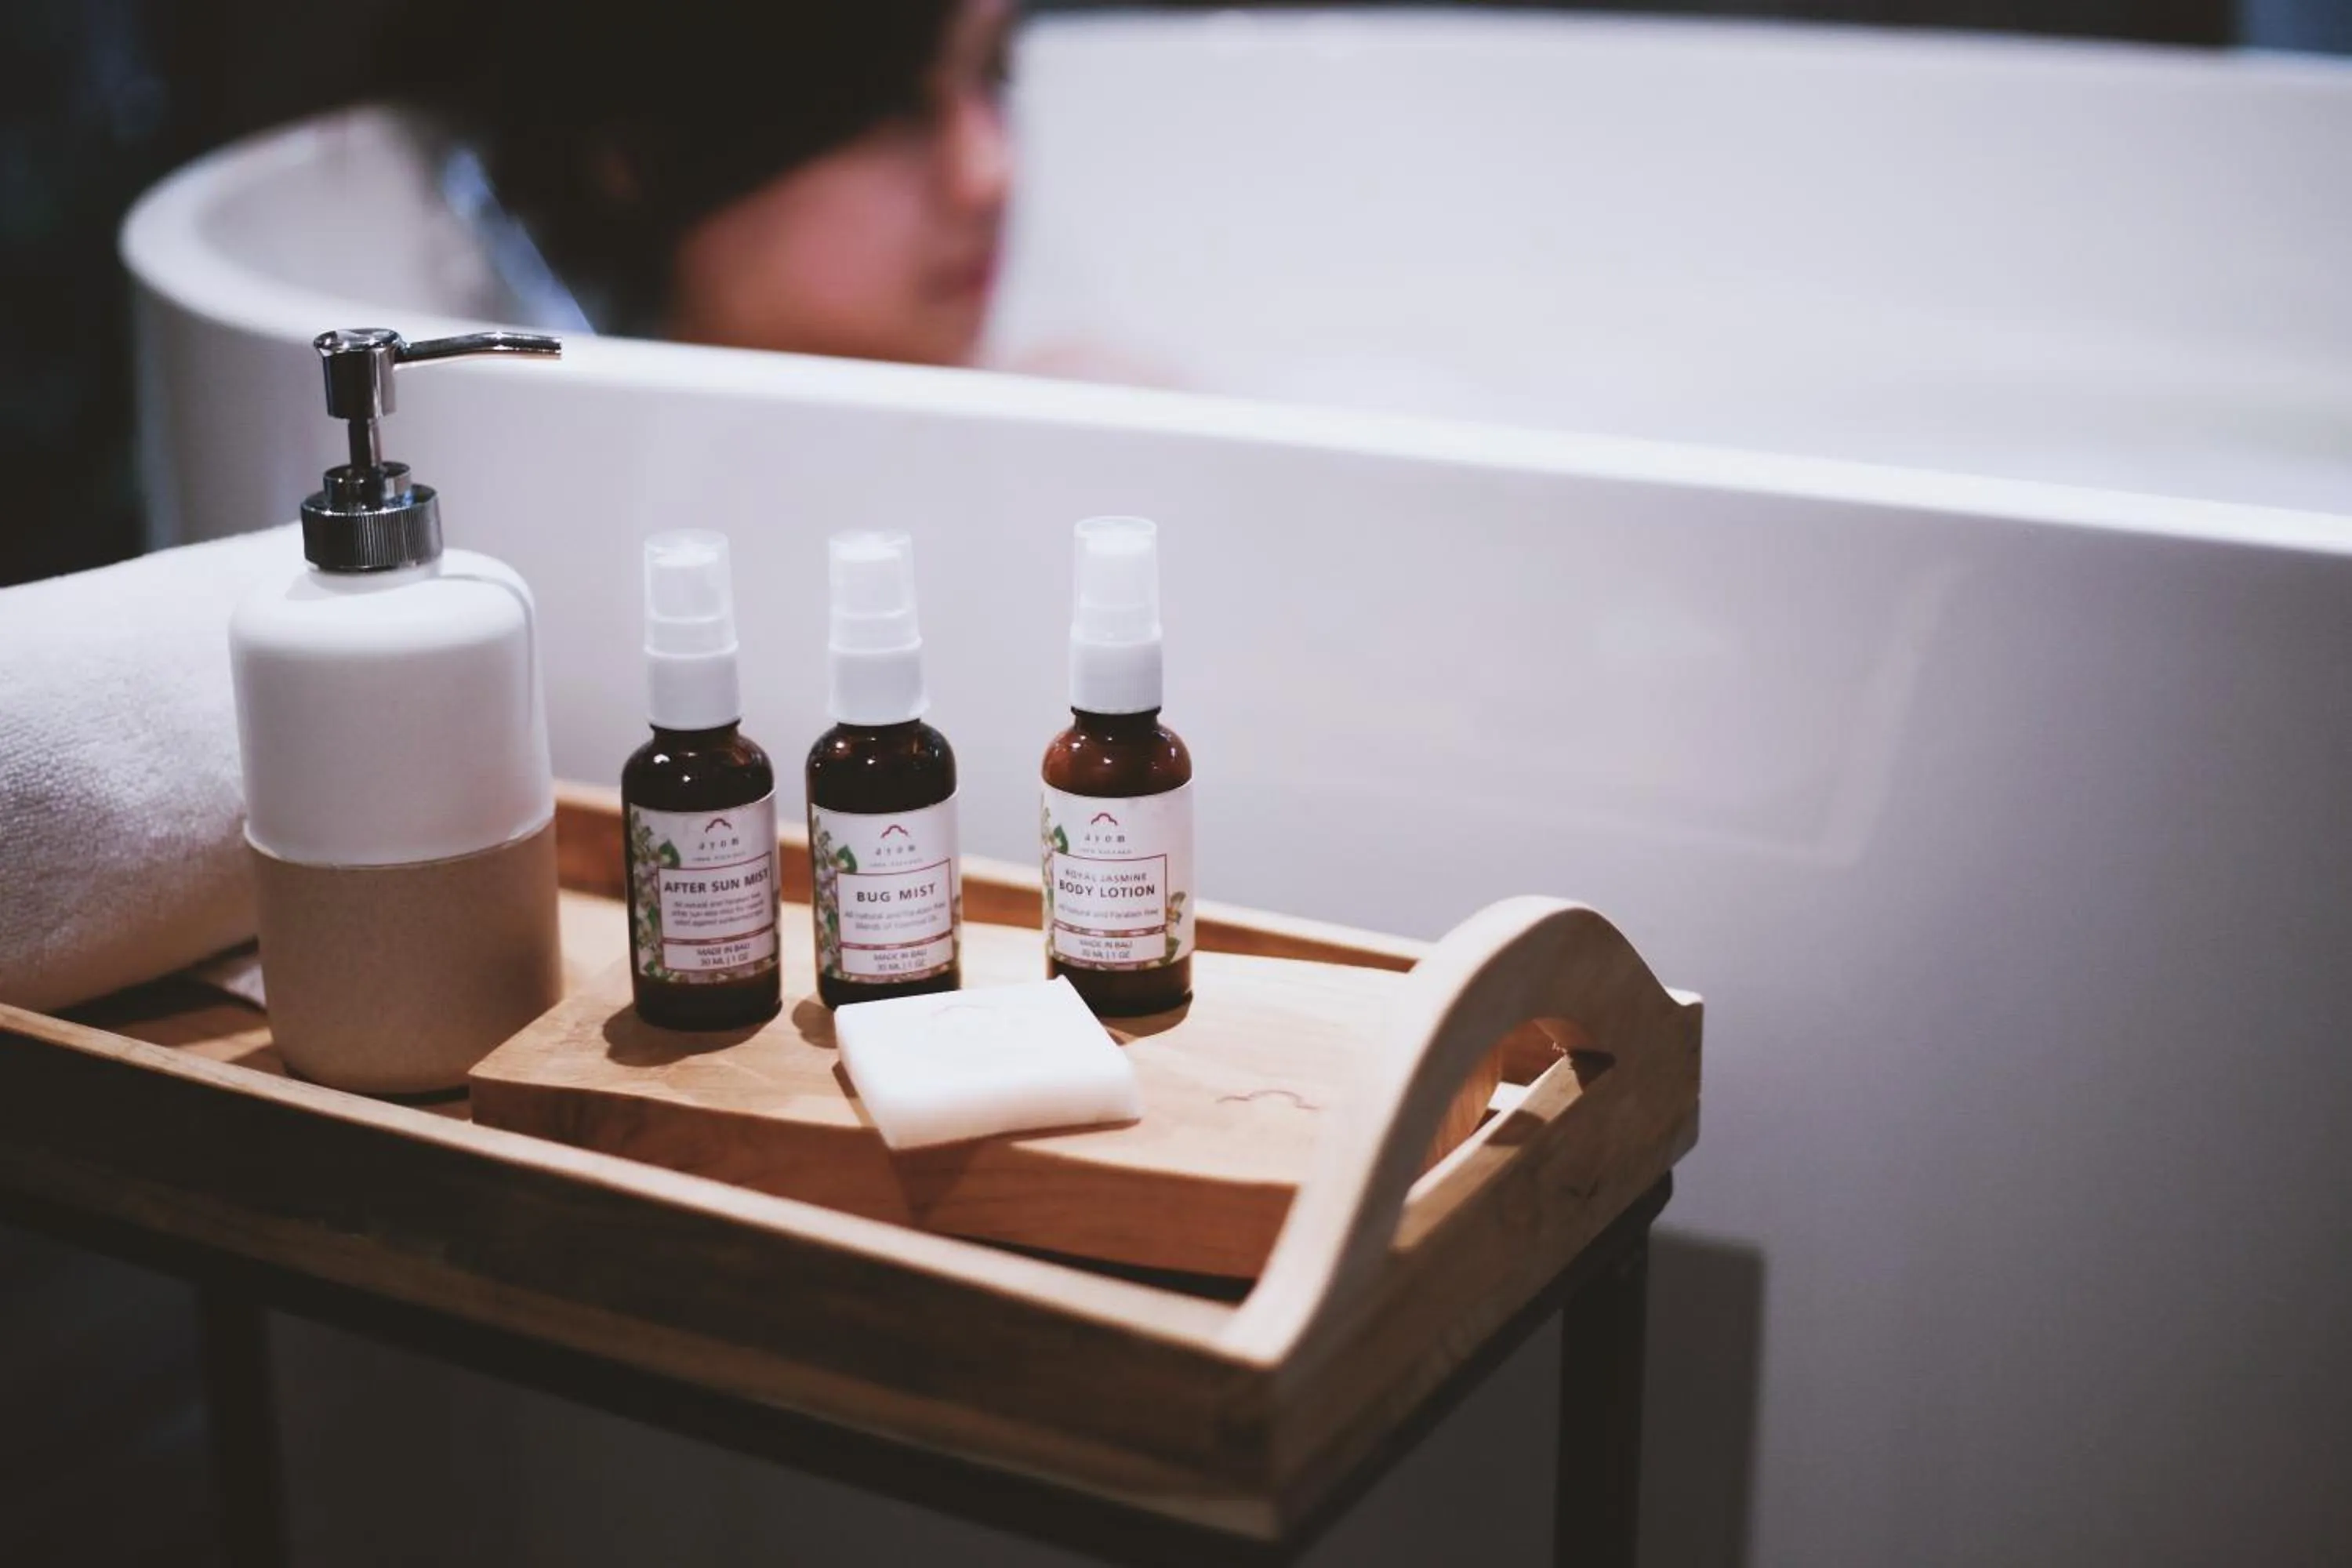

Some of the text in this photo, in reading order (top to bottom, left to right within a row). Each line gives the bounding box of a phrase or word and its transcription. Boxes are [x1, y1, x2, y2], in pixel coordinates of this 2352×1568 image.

[664, 868, 769, 894] AFTER SUN MIST
[1065, 869, 1147, 884] ROYAL JASMINE
[856, 883, 935, 902] BUG MIST
[1059, 879, 1155, 898] BODY LOTION
[697, 943, 750, 956] MADE IN BALI
[1105, 940, 1112, 949] IN
[701, 958, 711, 967] 30
[713, 956, 724, 965] ML
